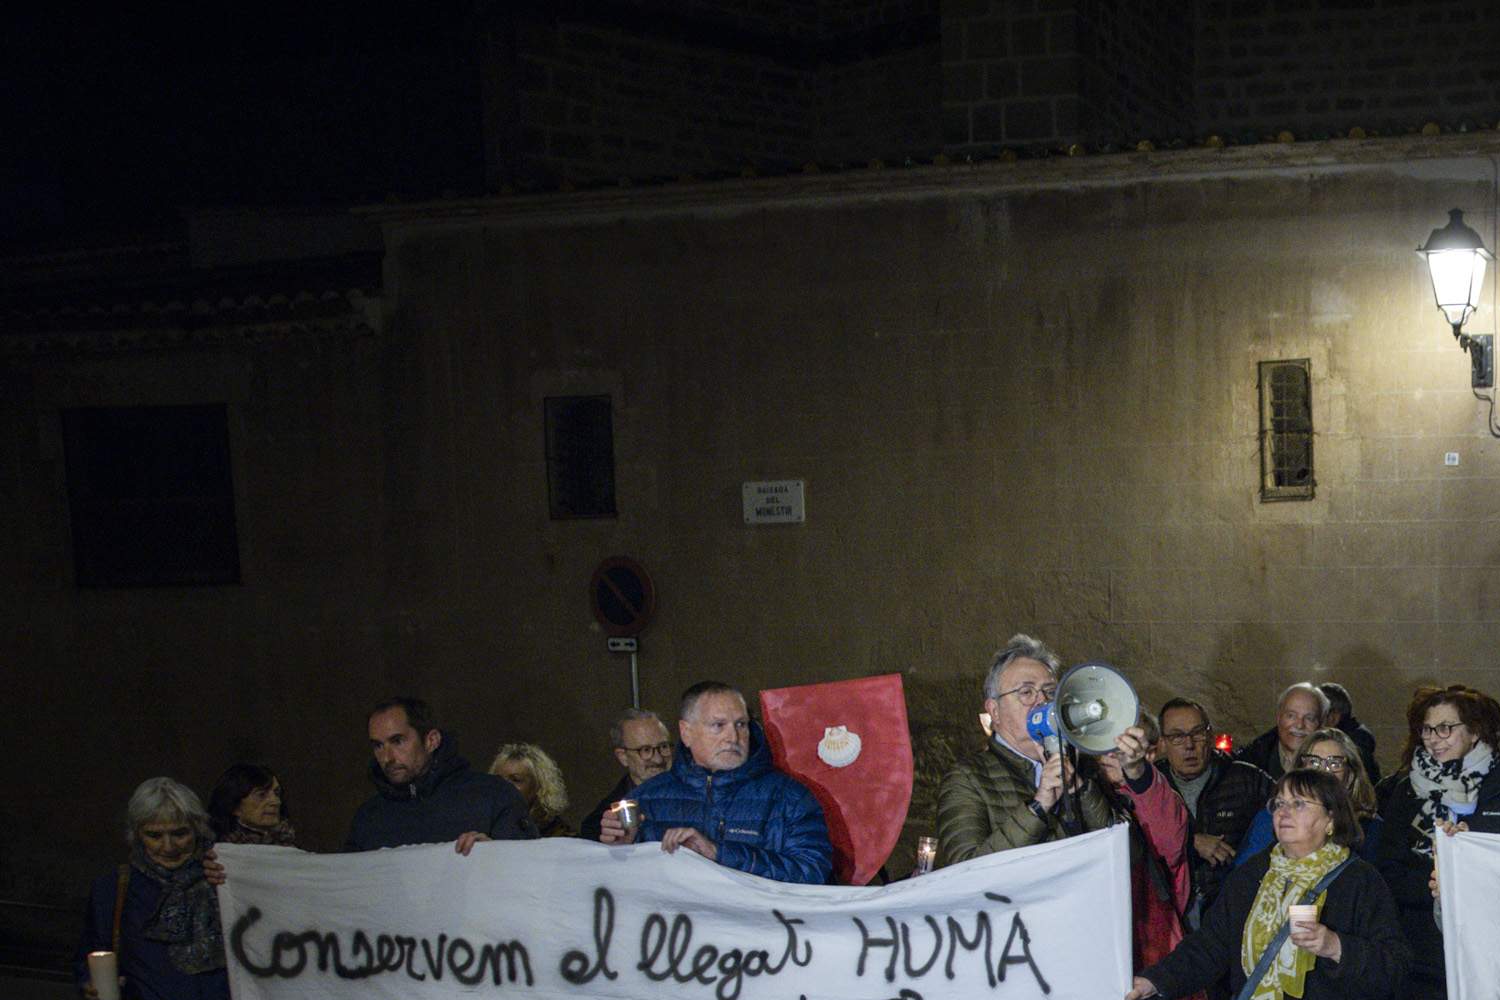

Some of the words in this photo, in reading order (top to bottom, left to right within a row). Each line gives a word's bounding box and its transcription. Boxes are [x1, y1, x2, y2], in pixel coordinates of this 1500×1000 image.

[230, 906, 534, 988] Conservem
[560, 886, 618, 986] el
[853, 891, 1050, 995] HUMÀ
